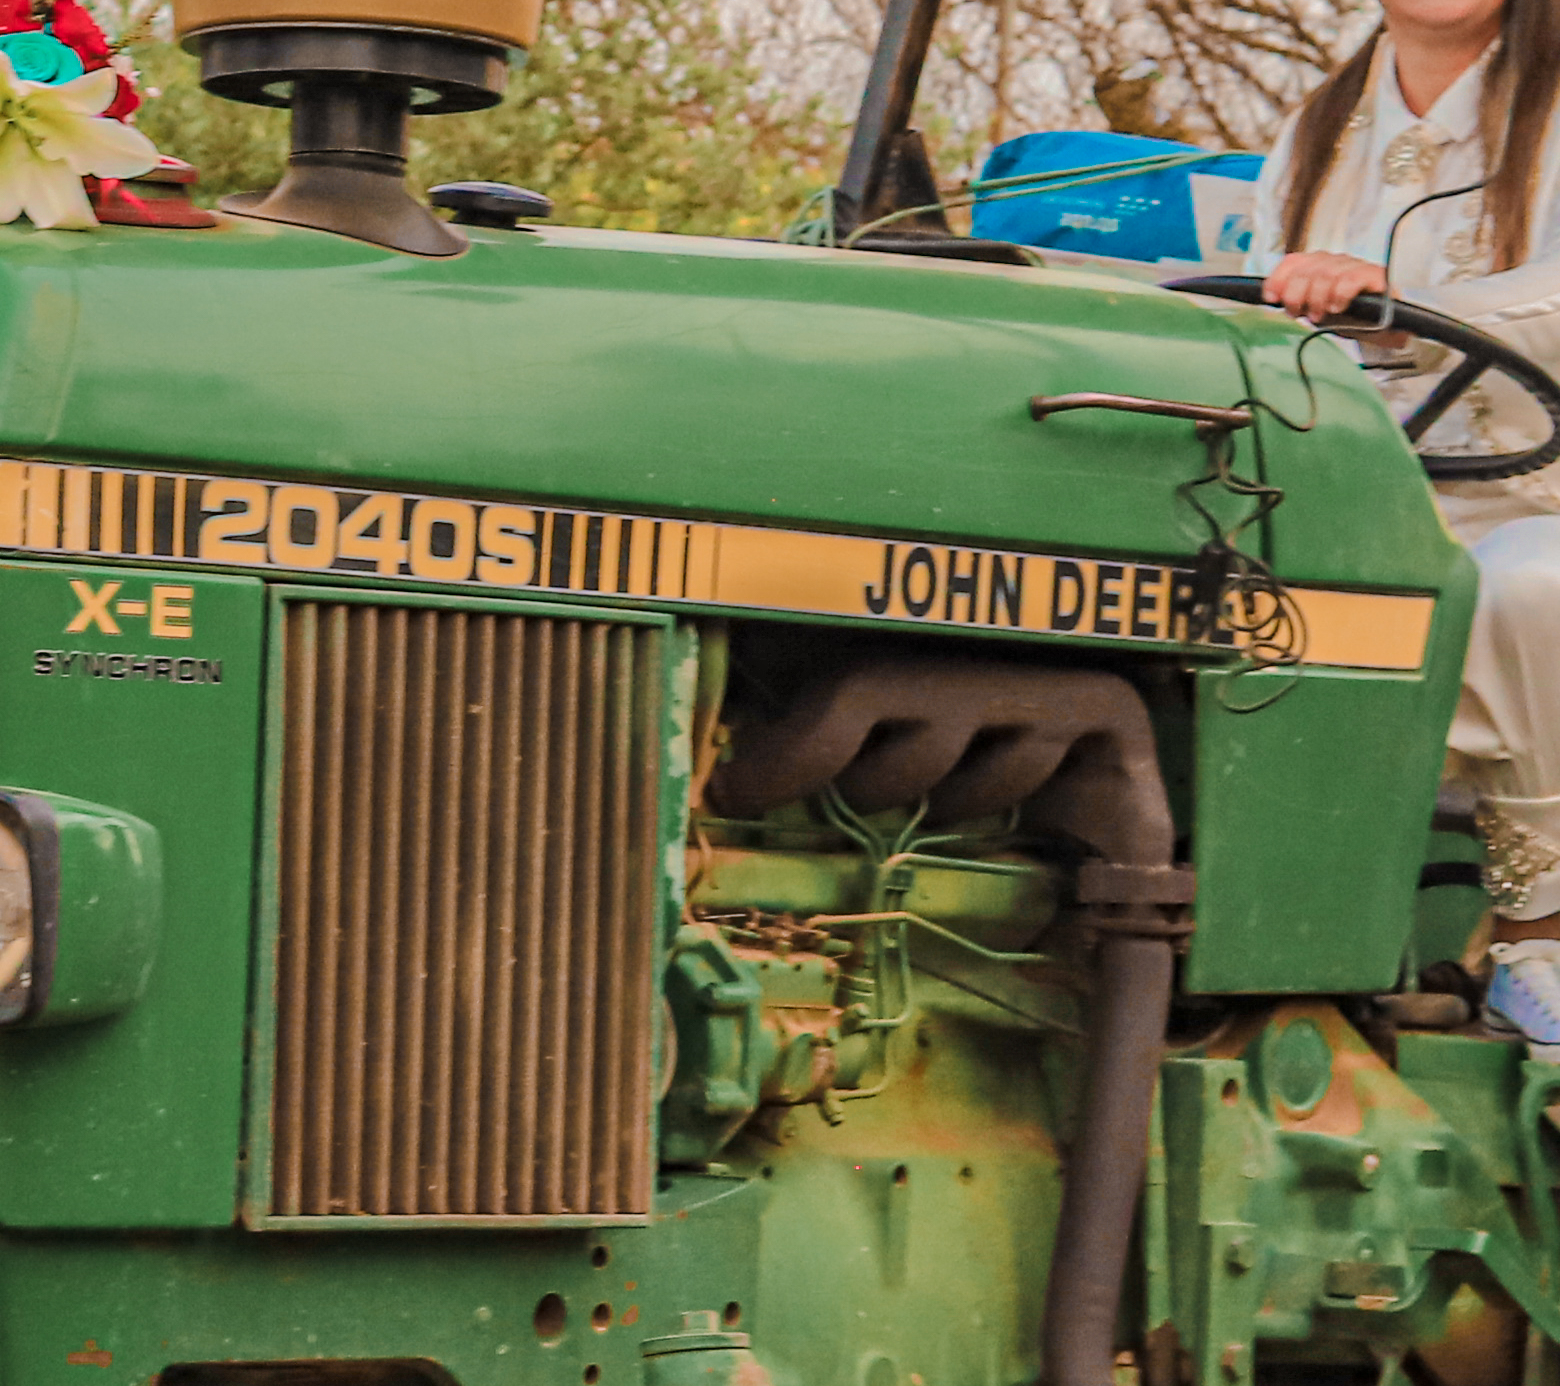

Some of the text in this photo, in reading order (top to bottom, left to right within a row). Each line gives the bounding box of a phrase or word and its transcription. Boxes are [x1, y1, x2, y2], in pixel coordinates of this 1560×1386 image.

[199, 479, 536, 587] 2040S
[64, 578, 194, 639] X-E
[863, 543, 1024, 627] JOHN
[33, 649, 222, 684] SYNCHRON
